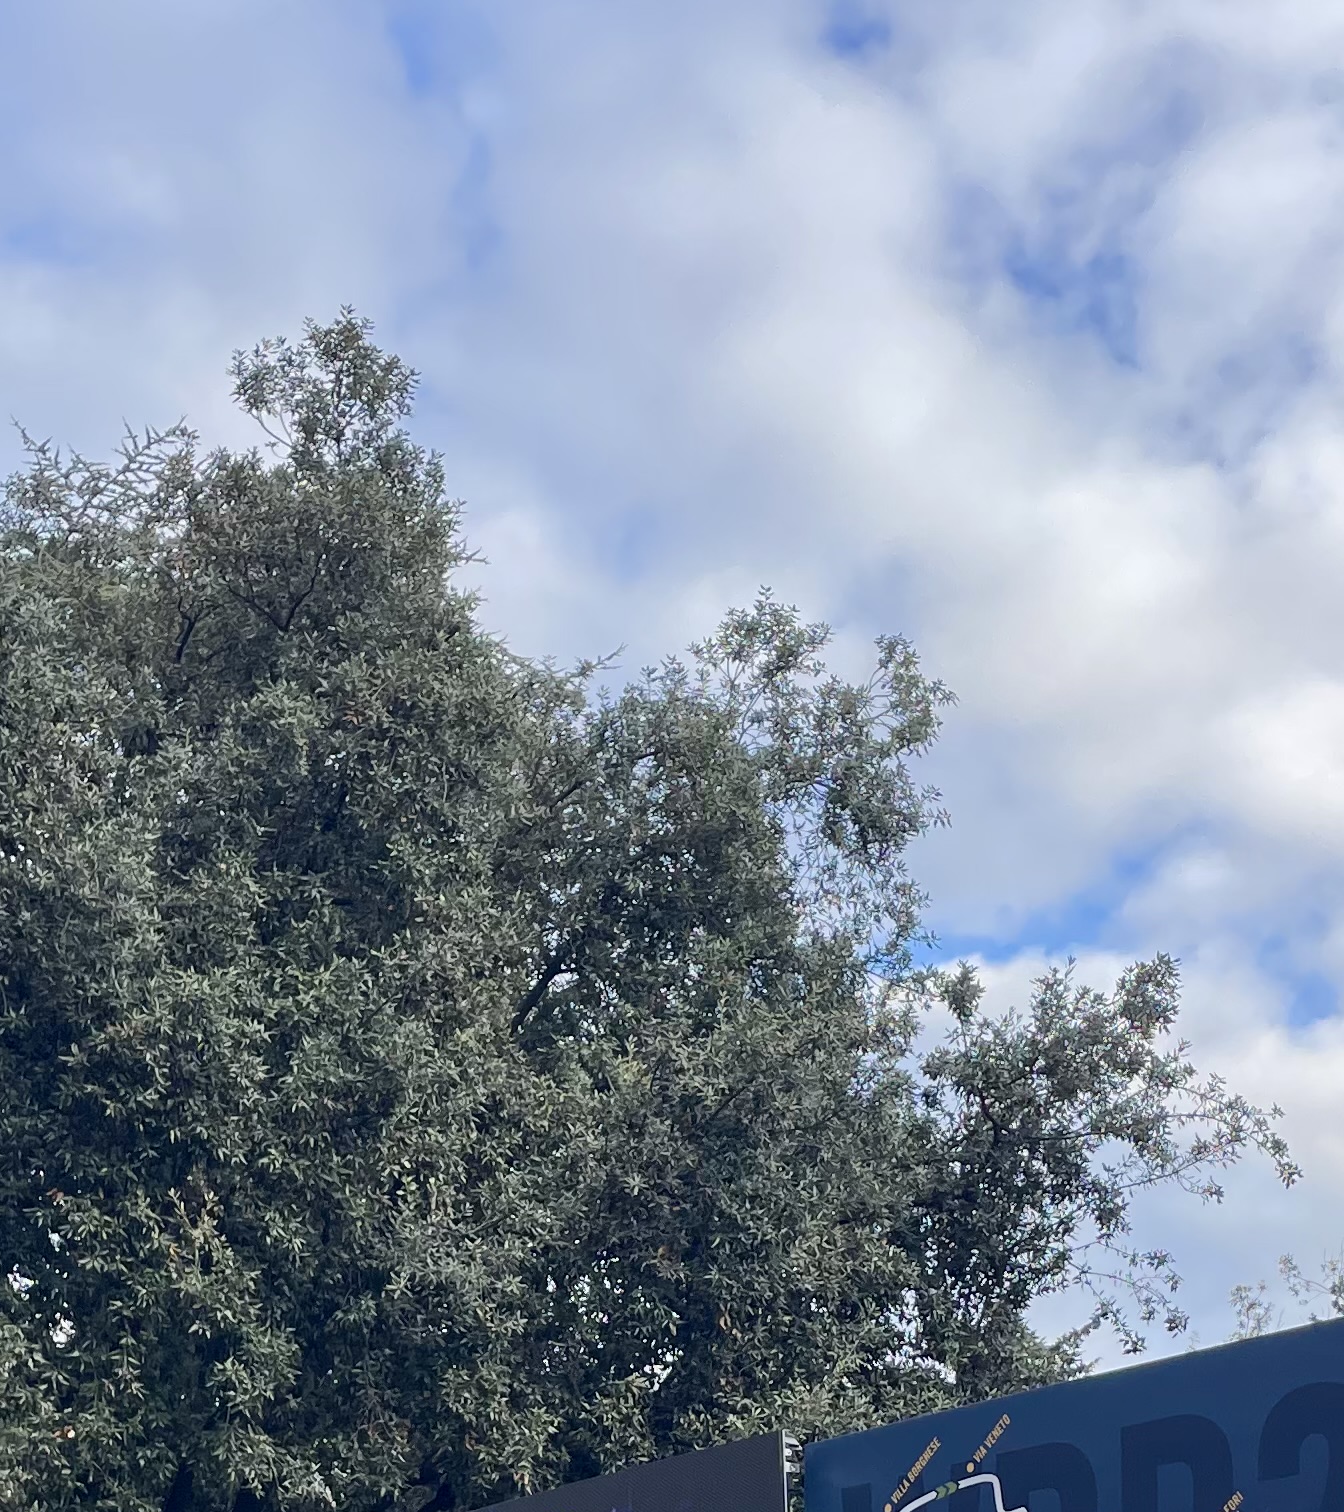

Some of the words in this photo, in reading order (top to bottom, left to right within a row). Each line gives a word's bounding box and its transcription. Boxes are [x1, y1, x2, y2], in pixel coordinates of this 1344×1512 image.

[972, 1445, 988, 1463] VIA
[983, 1413, 1011, 1449] VENETO
[890, 1478, 911, 1504] VILLA
[907, 1436, 942, 1483] BORGHESE
